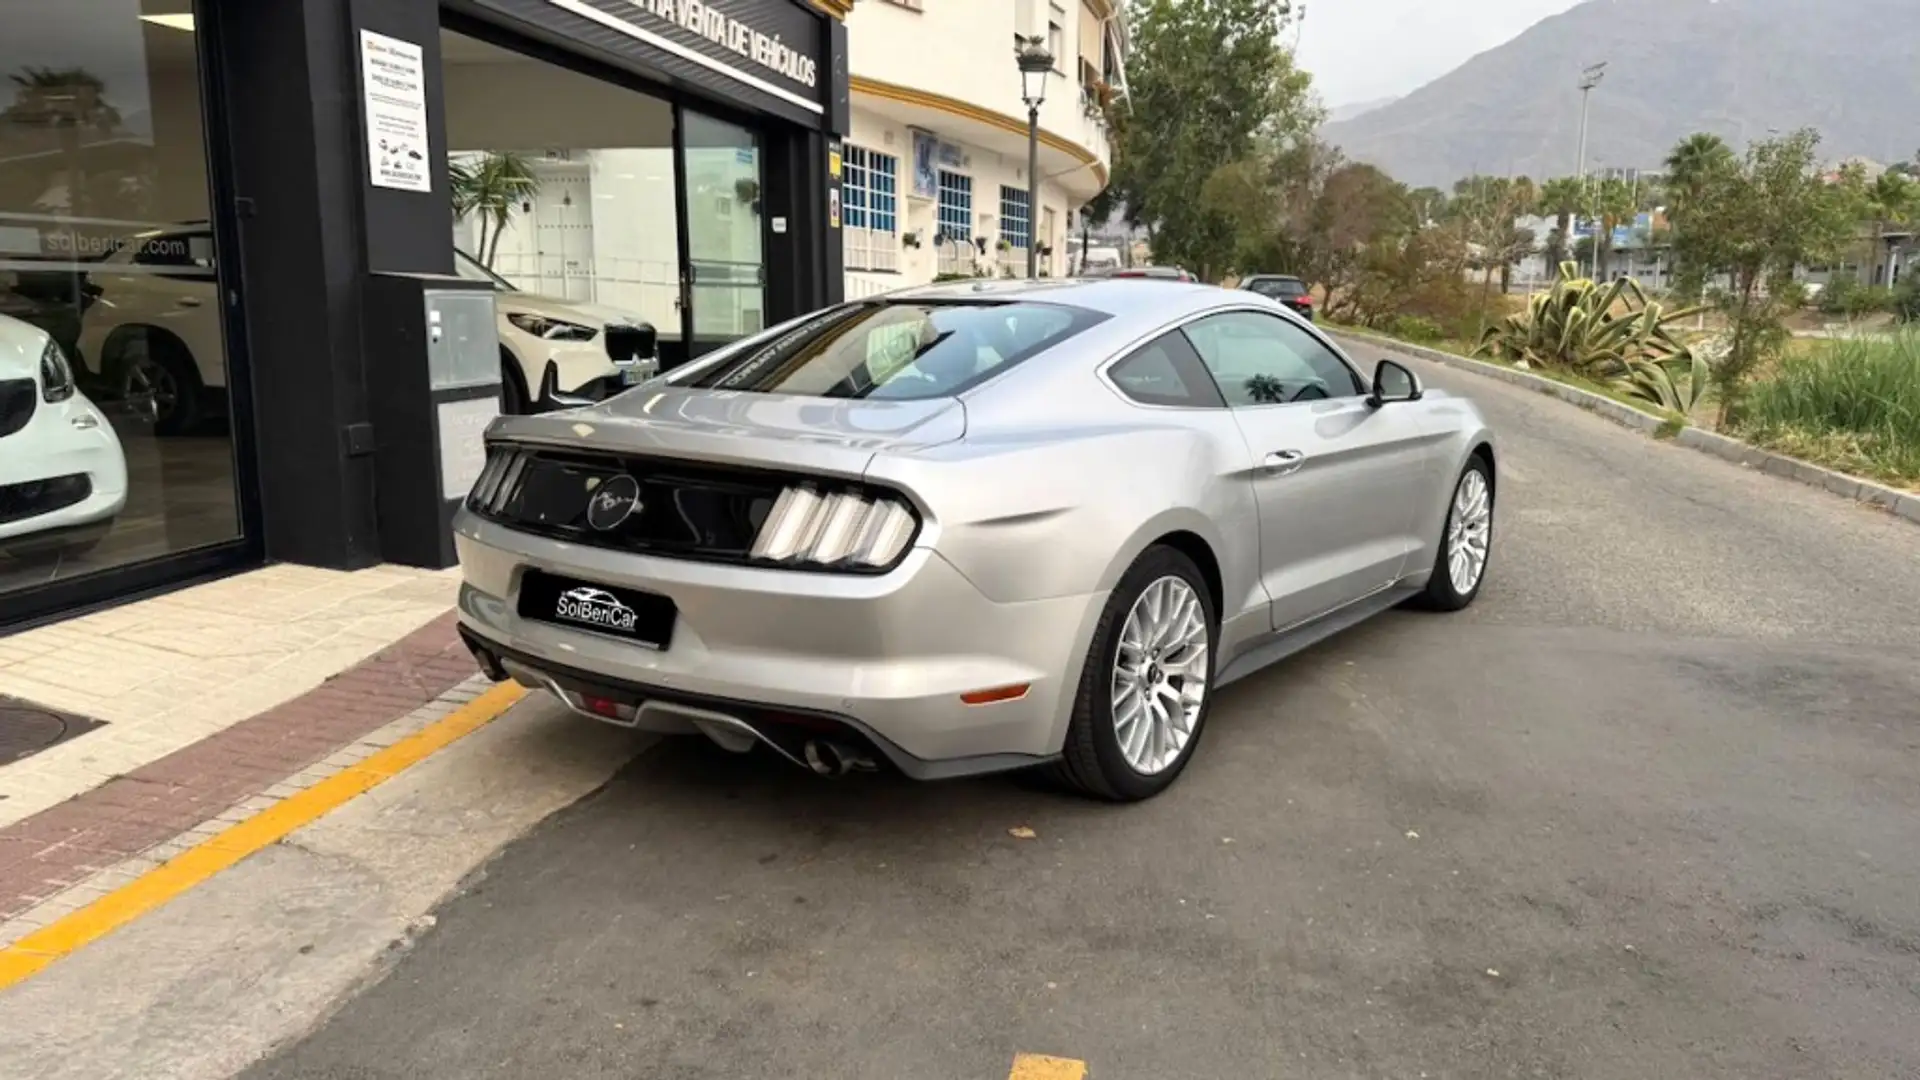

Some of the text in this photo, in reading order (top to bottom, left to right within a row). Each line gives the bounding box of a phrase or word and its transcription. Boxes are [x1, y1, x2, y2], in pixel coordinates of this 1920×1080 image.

[677, 0, 729, 47] VENTA
[728, 18, 749, 56] DE
[748, 28, 816, 88] VEHÍCULOS
